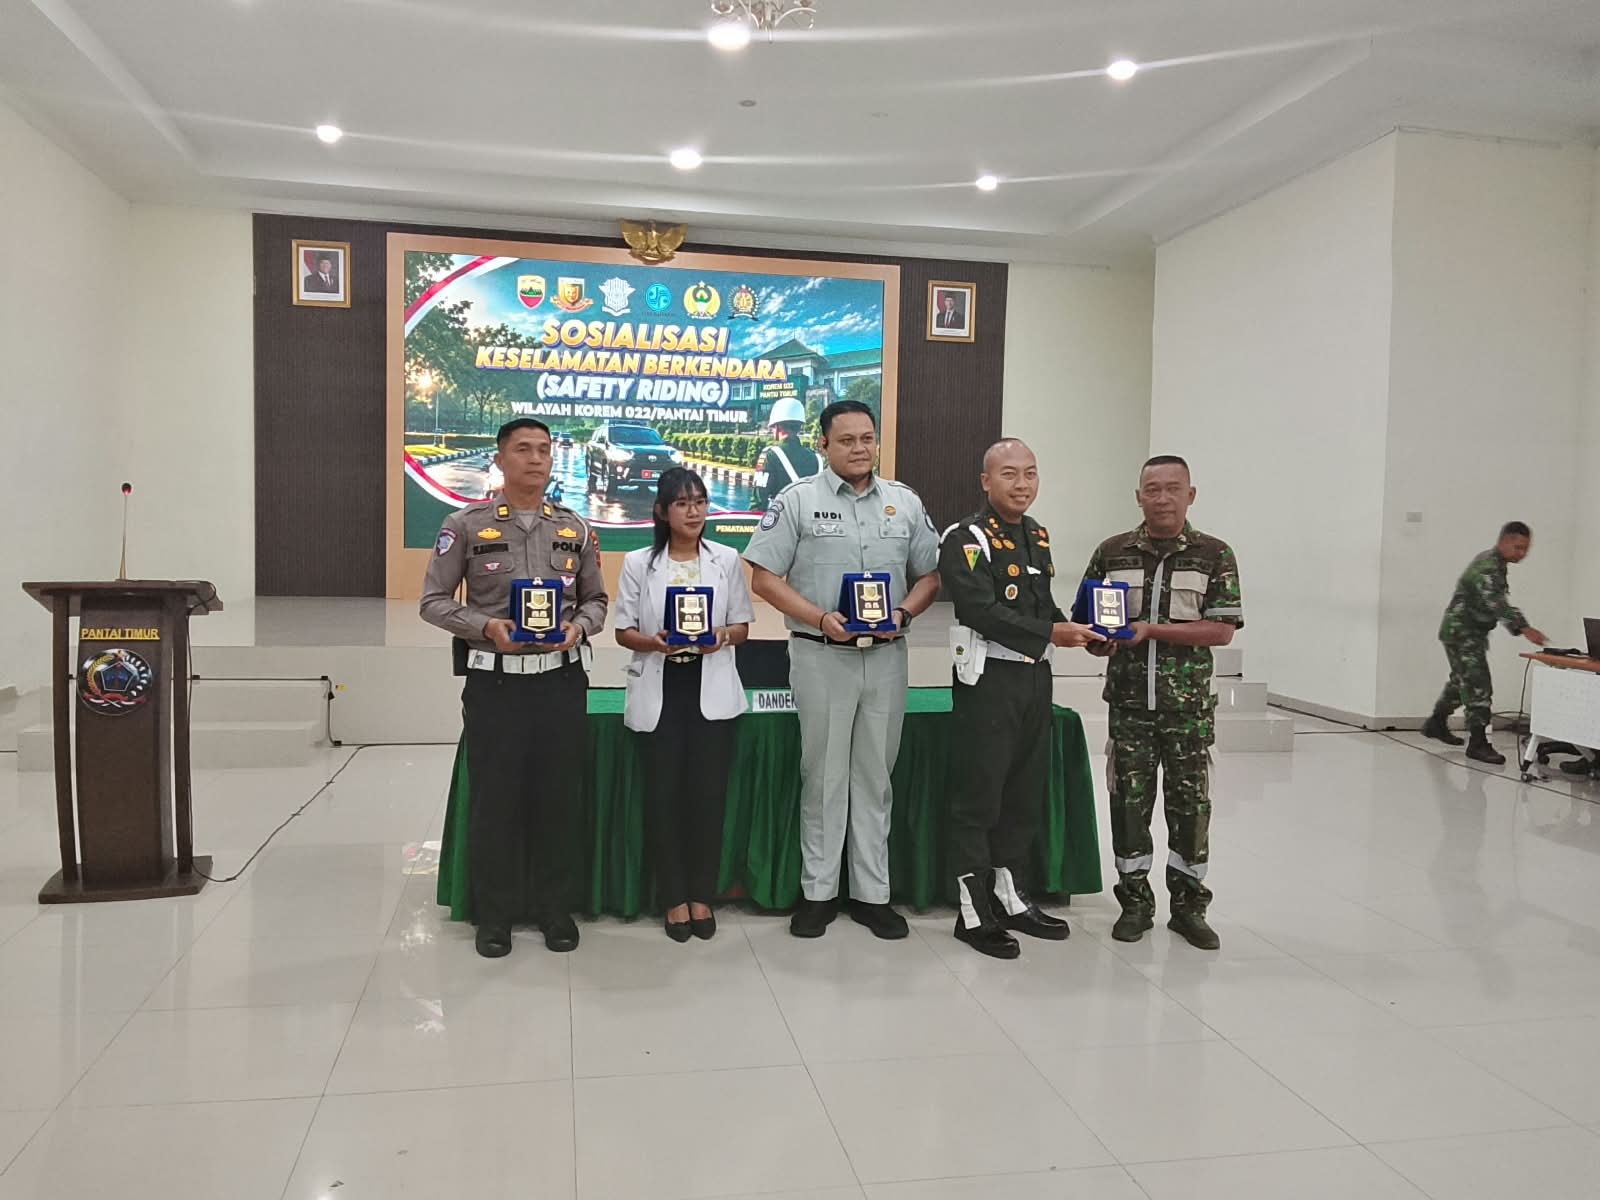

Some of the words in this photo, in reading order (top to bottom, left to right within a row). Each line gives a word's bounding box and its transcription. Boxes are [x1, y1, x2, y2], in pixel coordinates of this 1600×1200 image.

[542, 318, 728, 353] SOSIALISASI
[475, 345, 640, 374] KESELAMATAN
[643, 353, 786, 380] BERKENDARA
[536, 372, 634, 400] (SAFETY
[636, 377, 730, 408] RIDING)
[511, 401, 572, 417] WILAYAH
[575, 404, 622, 418] KOREM
[625, 406, 704, 421] 022/PANTAI
[706, 409, 748, 423] TIMUR
[814, 511, 842, 520] RUDI
[716, 525, 757, 533] PEMATANG
[81, 628, 121, 639] PANTAI
[125, 628, 159, 639] TIMUR
